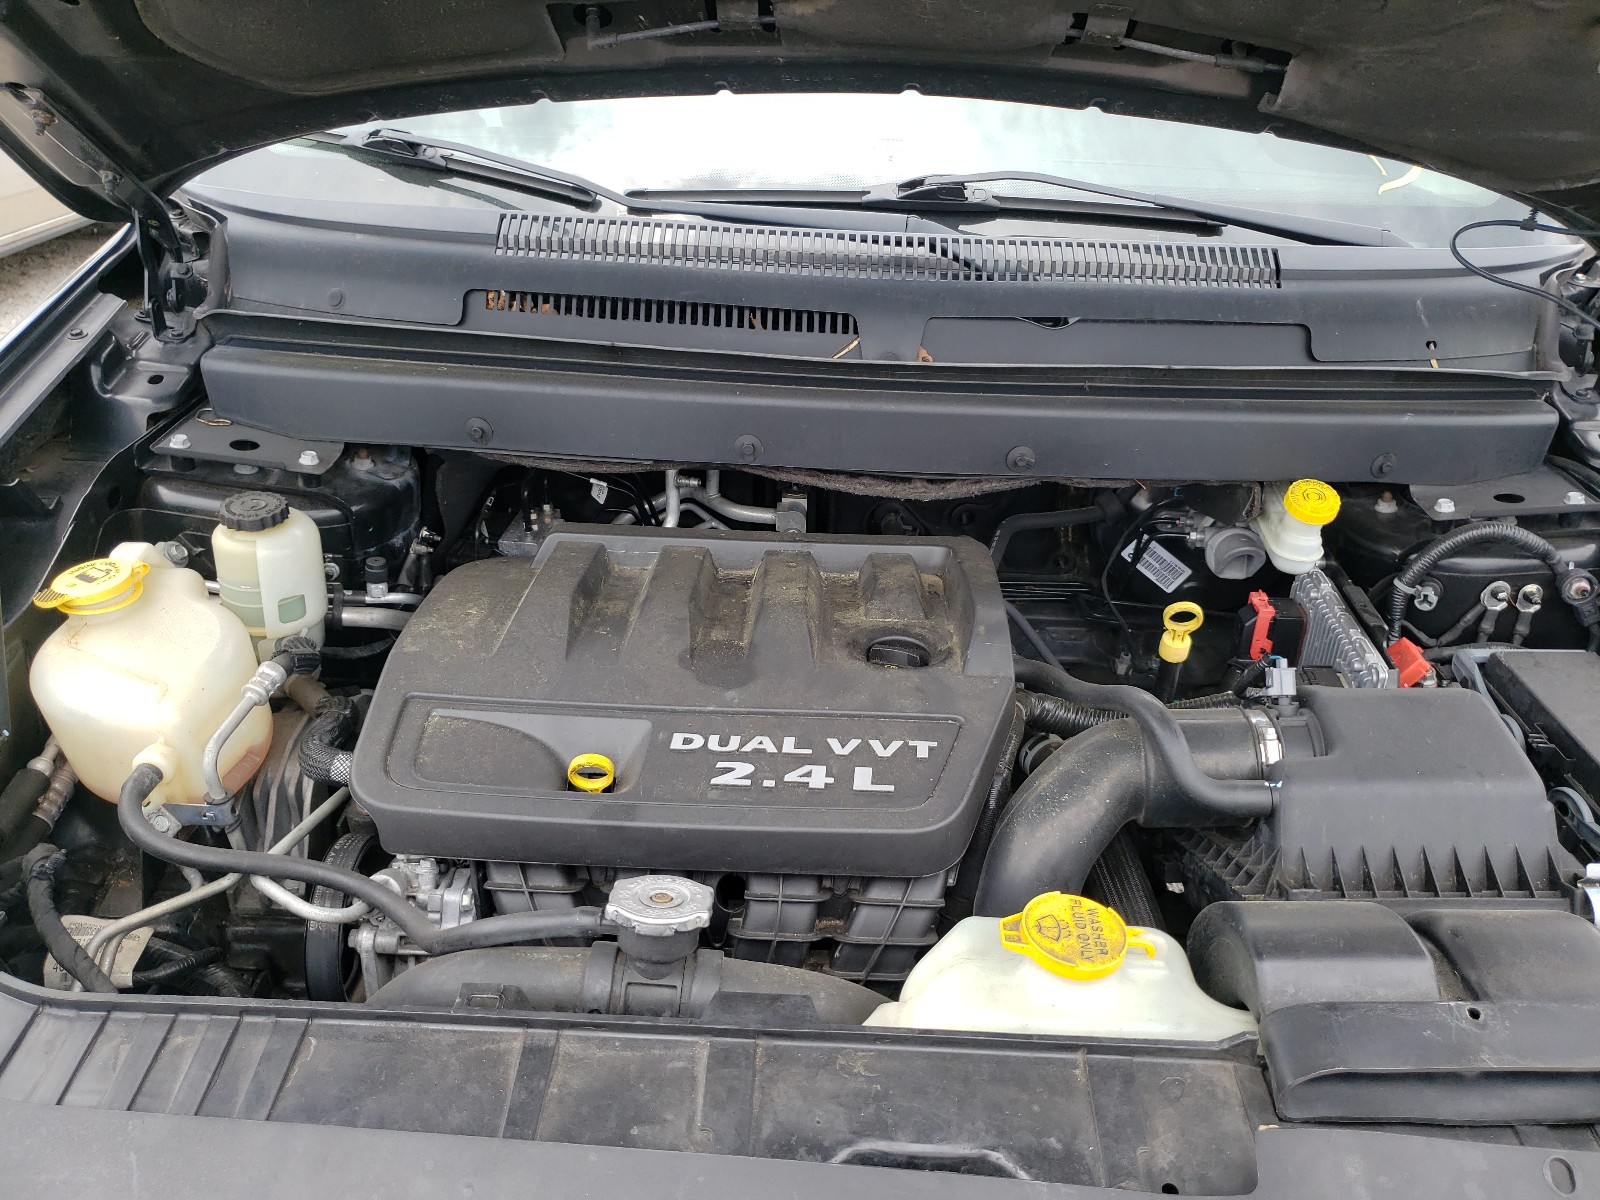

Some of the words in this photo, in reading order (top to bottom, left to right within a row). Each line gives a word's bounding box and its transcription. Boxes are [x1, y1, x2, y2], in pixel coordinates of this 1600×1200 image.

[669, 732, 813, 755] DUAL
[826, 737, 938, 759] VVT
[1070, 899, 1087, 930] FLUID
[1087, 907, 1109, 956] WASHER
[1077, 933, 1095, 964] ONLY
